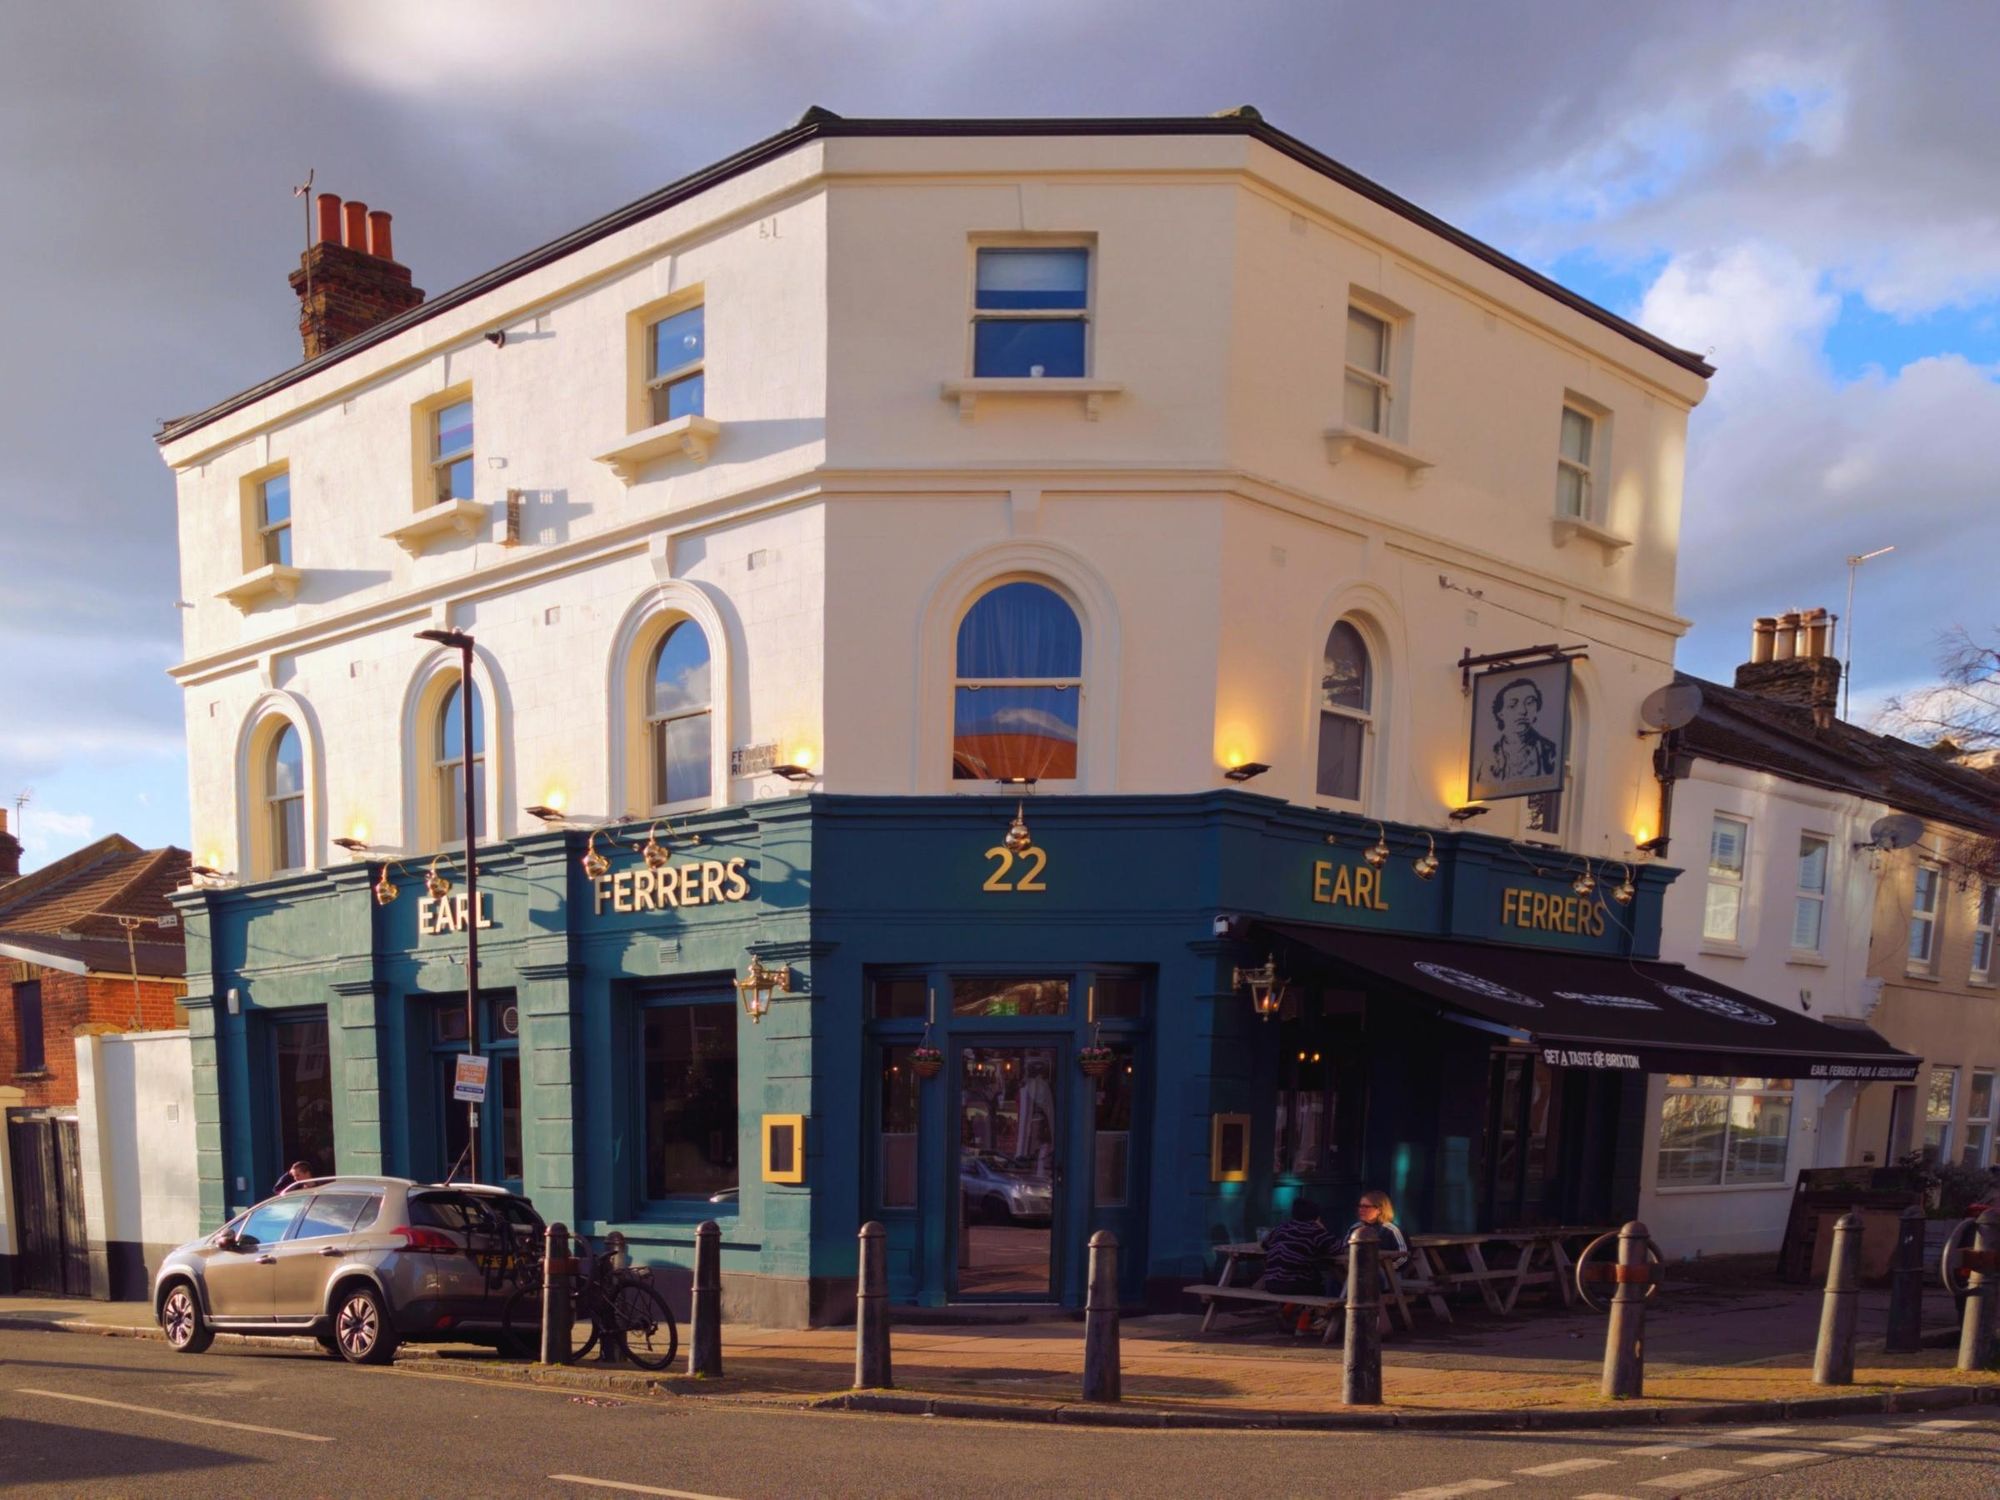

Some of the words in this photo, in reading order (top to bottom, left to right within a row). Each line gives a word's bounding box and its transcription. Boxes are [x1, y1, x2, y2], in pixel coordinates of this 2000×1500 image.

[419, 890, 491, 934] EARL
[594, 856, 748, 916] FERRERS
[983, 846, 1047, 891] 22
[1314, 860, 1389, 911] EARL
[1503, 887, 1606, 937] FERRERS
[1544, 1049, 1561, 1064] GET
[1561, 1050, 1569, 1067] A
[1568, 1051, 1593, 1066] TASTE
[1593, 1051, 1606, 1068] OF
[1605, 1053, 1640, 1069] BRIXTON
